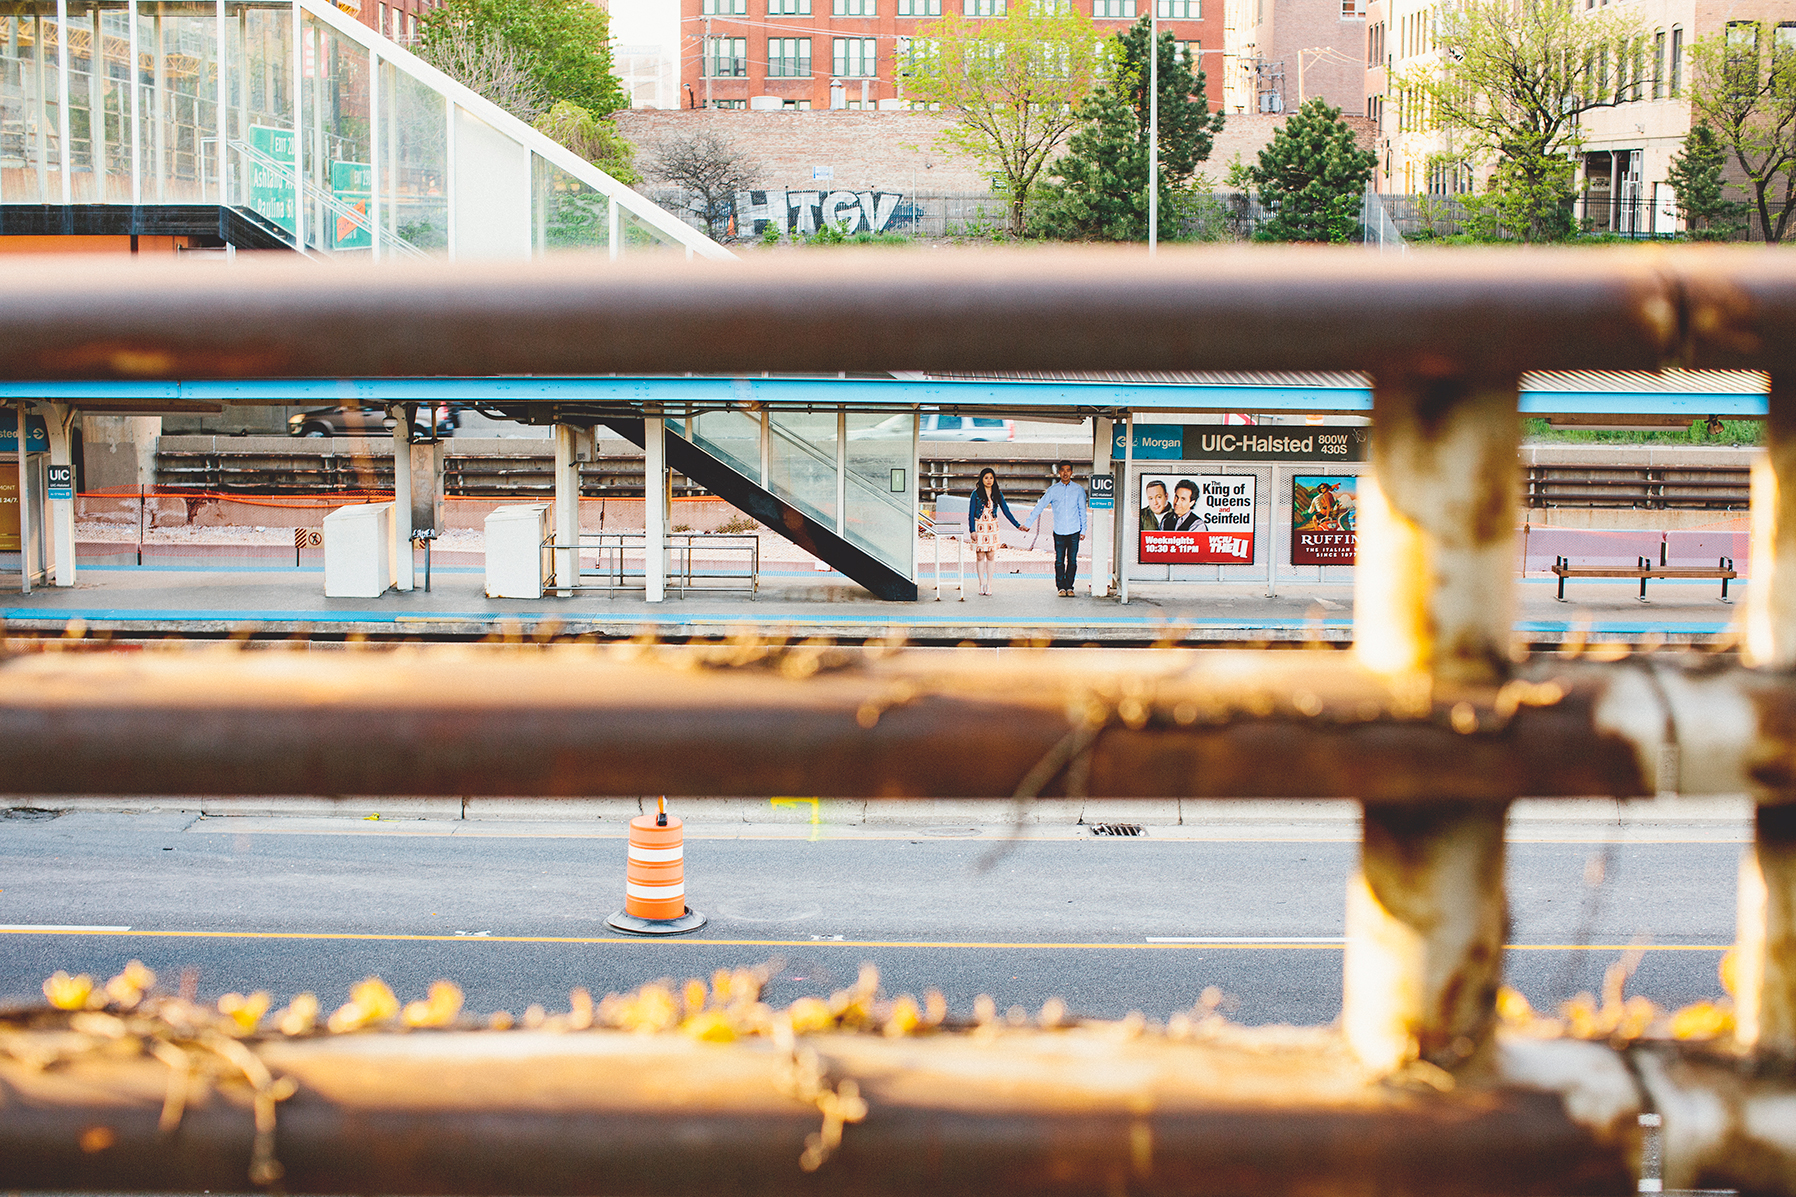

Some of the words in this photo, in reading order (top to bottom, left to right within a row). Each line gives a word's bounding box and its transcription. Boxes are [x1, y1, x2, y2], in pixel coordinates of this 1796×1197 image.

[257, 196, 284, 218] Paulina
[1142, 437, 1181, 450] Morgan
[1201, 434, 1314, 453] UIC-Halsted
[1318, 434, 1348, 445] 800W
[1320, 444, 1348, 455] 430S
[49, 469, 70, 481] UIC
[1092, 478, 1113, 490] UIC
[1202, 483, 1230, 497] King
[1233, 484, 1246, 495] of
[1206, 495, 1251, 508] Queens
[1204, 513, 1250, 524] Seinfeld
[1145, 536, 1195, 546] Weeknights
[1145, 545, 1168, 553] 10:30
[1170, 545, 1176, 553] &
[1179, 545, 1199, 553] 11PM
